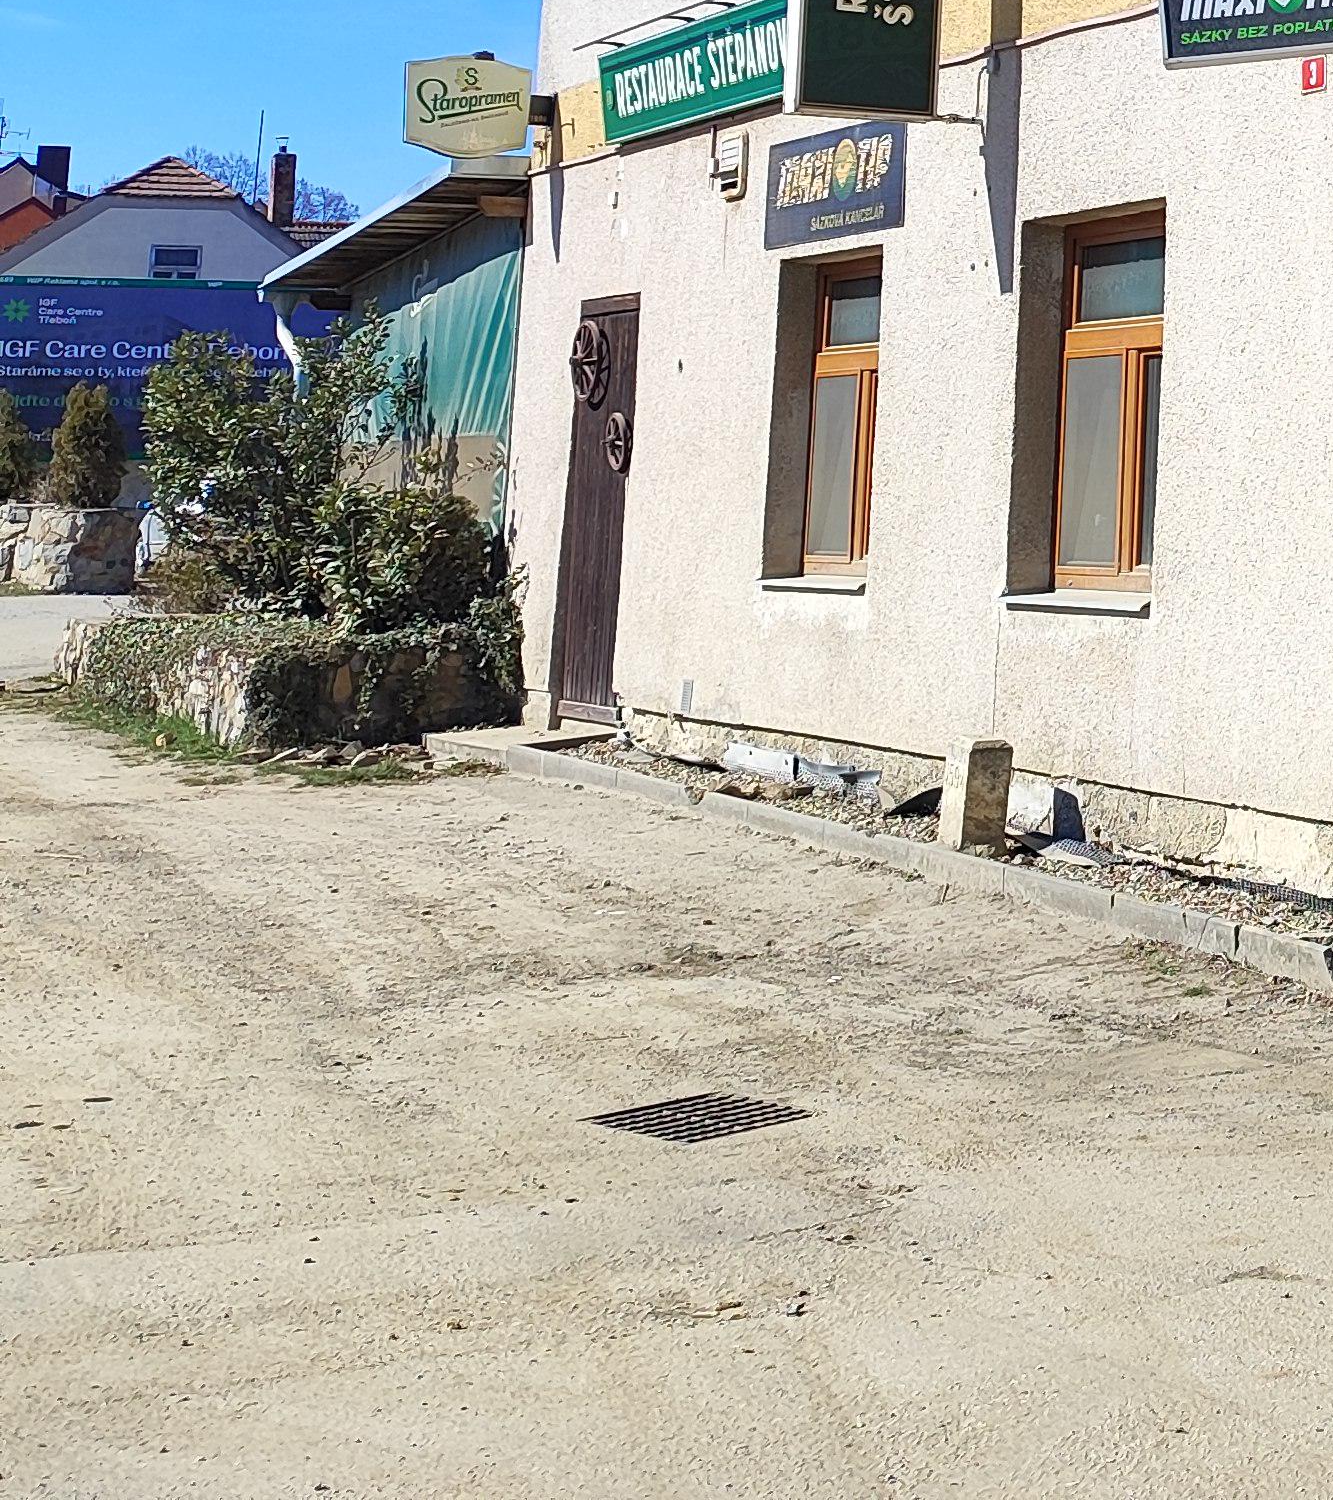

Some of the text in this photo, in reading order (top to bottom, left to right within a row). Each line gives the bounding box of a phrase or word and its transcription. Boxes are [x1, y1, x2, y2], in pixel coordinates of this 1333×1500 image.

[1180, 27, 1234, 45] SÁZKY
[1237, 25, 1270, 40] BEZ
[614, 19, 788, 119] RESTAURACE ŠTĚPÁNOV
[1308, 60, 1318, 87] 3
[416, 78, 524, 124] Staropramen
[0, 339, 40, 358] IGF
[45, 340, 107, 359] Care
[112, 341, 200, 360] Cent
[84, 367, 95, 377] o
